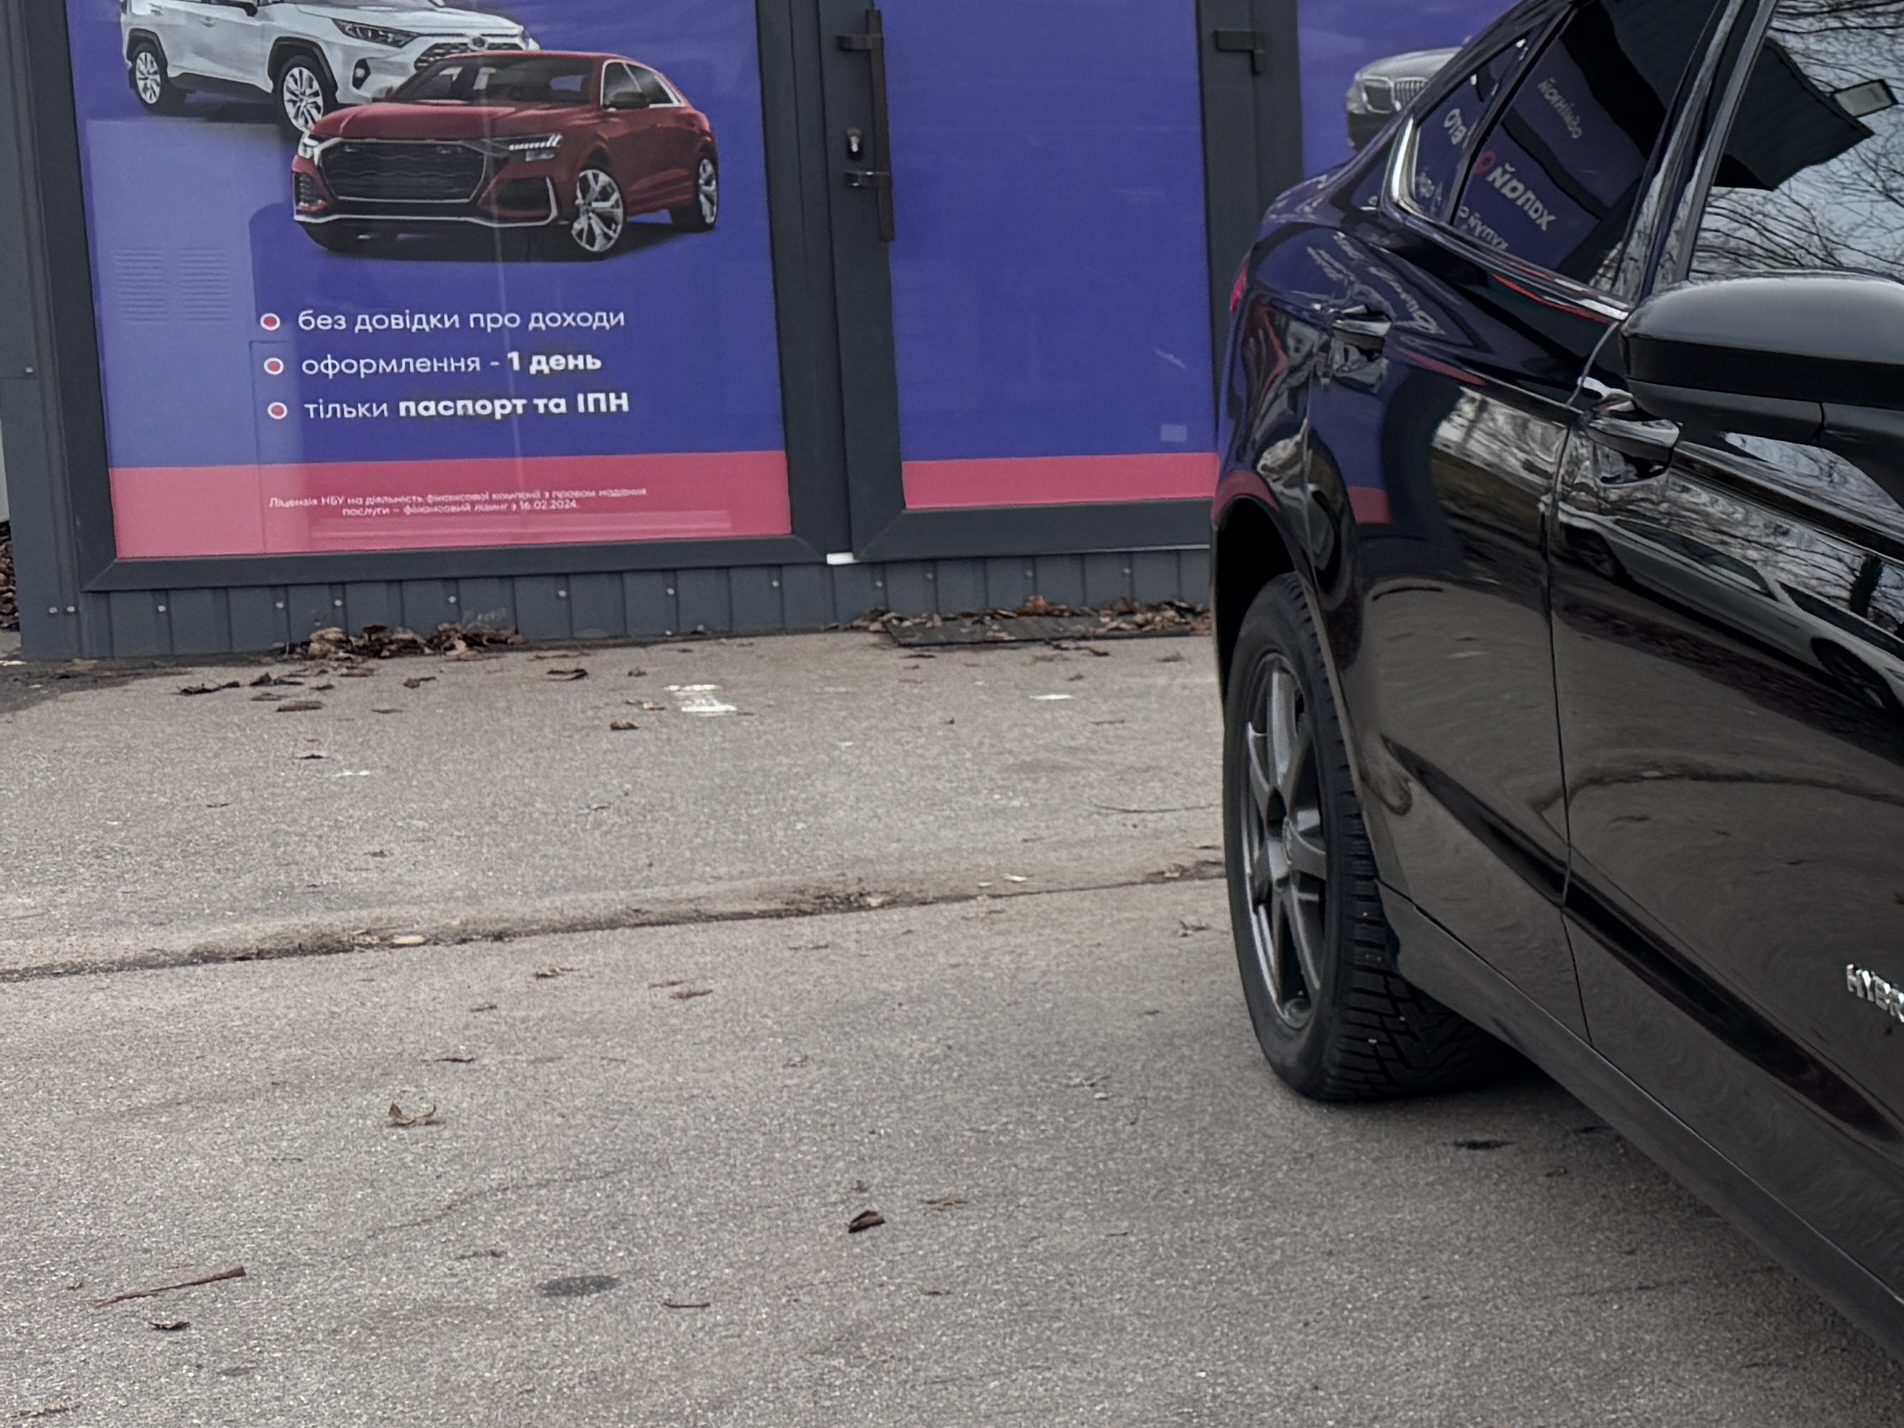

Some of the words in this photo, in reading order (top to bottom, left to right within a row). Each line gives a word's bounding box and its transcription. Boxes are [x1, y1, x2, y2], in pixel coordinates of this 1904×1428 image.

[298, 309, 348, 332] без
[355, 309, 460, 333] довідки
[469, 311, 520, 335] про
[529, 309, 626, 332] доходи
[302, 352, 482, 377] оформлення
[507, 351, 521, 371] 1
[529, 351, 602, 375] день
[304, 397, 389, 420] тільки
[398, 395, 527, 421] паспорт
[533, 395, 568, 415] та
[576, 392, 630, 415] ІПН
